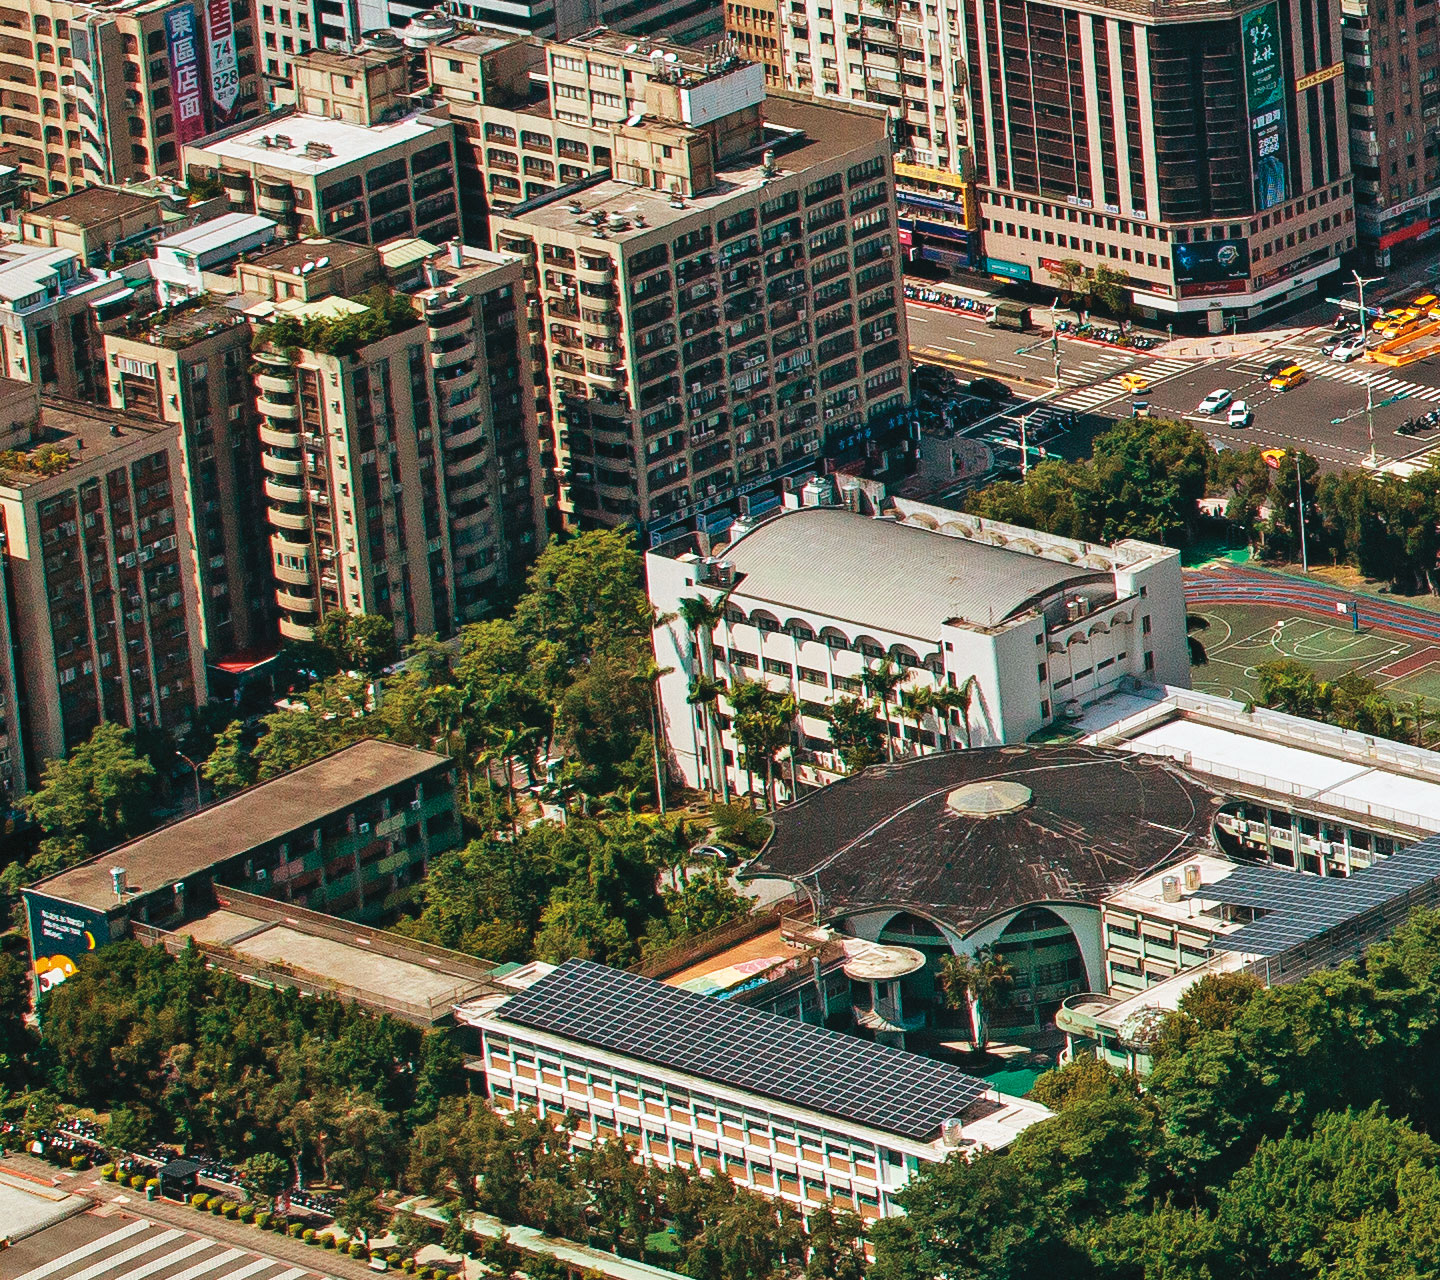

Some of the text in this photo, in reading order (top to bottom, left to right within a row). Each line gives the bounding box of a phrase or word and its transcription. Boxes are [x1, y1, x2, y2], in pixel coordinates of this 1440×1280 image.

[213, 41, 232, 59] 74
[169, 10, 200, 121] 東區店面
[213, 70, 239, 92] 328
